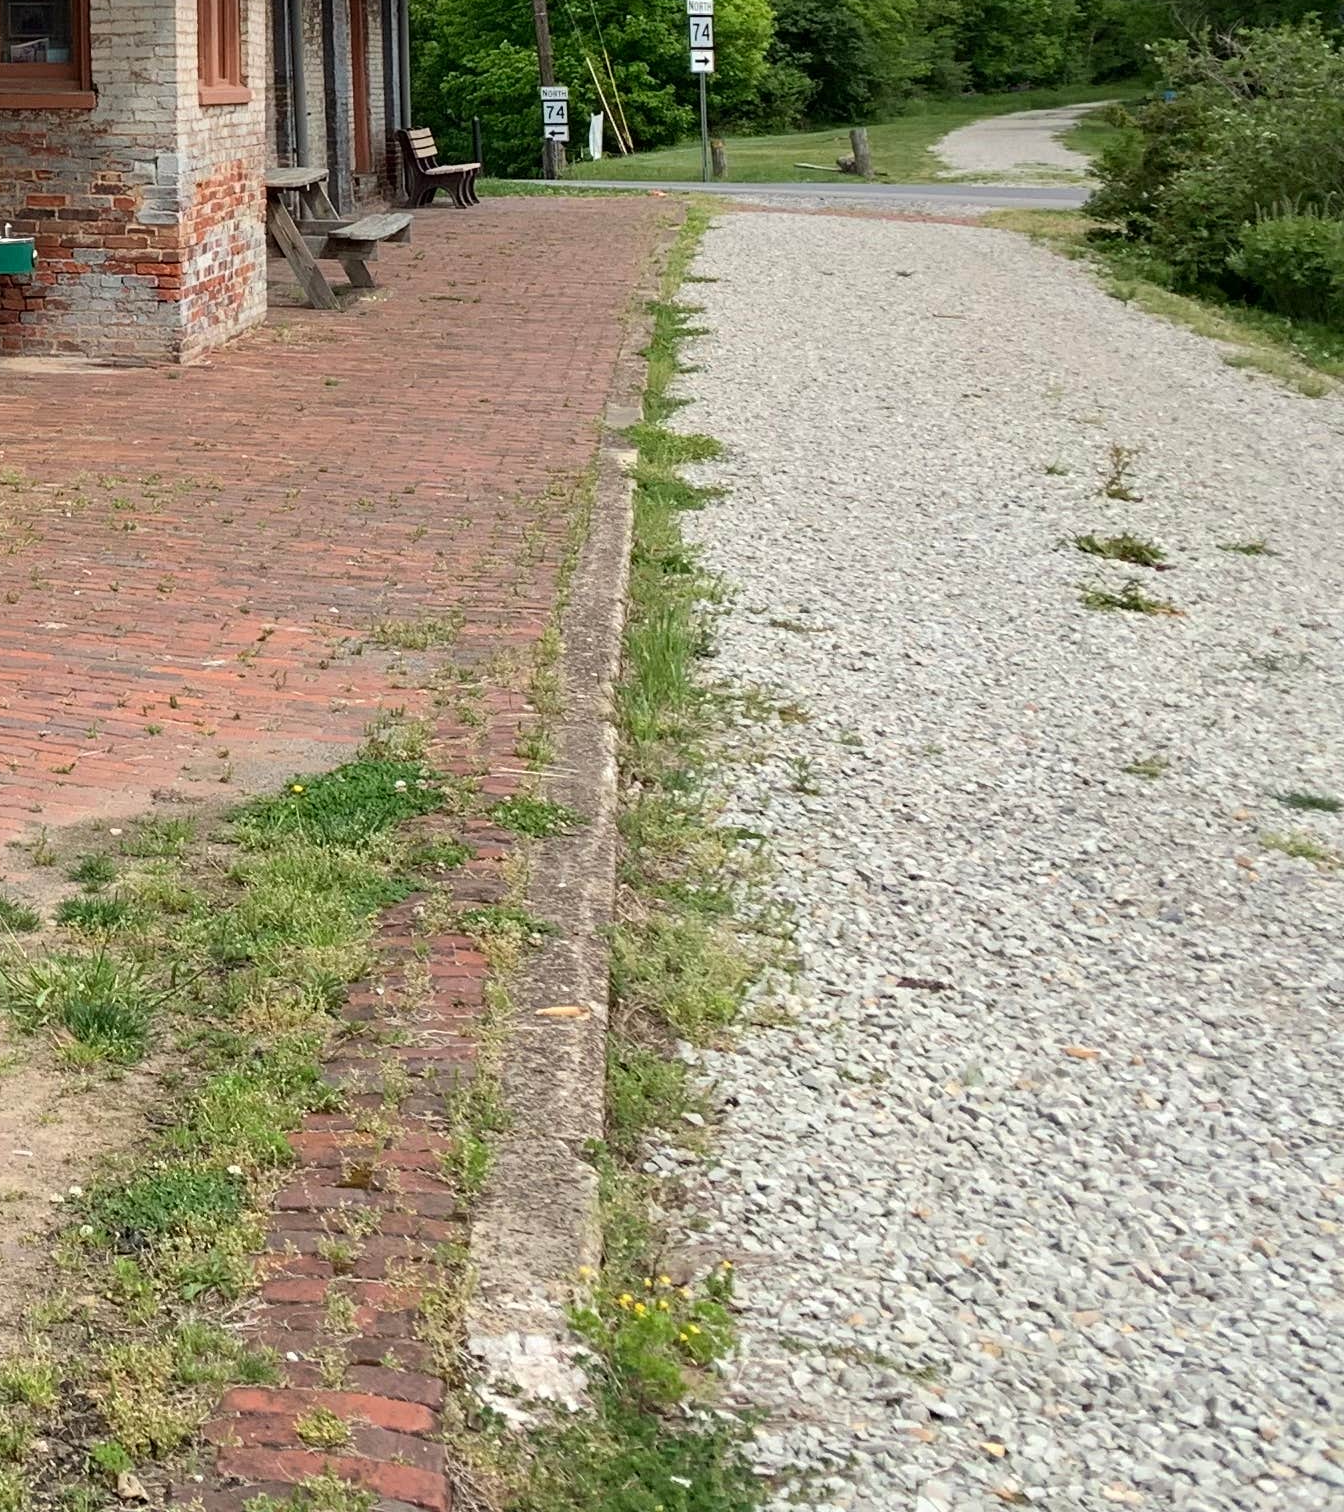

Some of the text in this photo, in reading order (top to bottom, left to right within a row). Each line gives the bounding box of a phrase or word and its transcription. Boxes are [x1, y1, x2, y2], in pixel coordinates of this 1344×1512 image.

[688, 0, 712, 12] NORTH
[692, 23, 710, 41] 74
[542, 89, 567, 98] NORTH
[546, 105, 565, 120] 74
